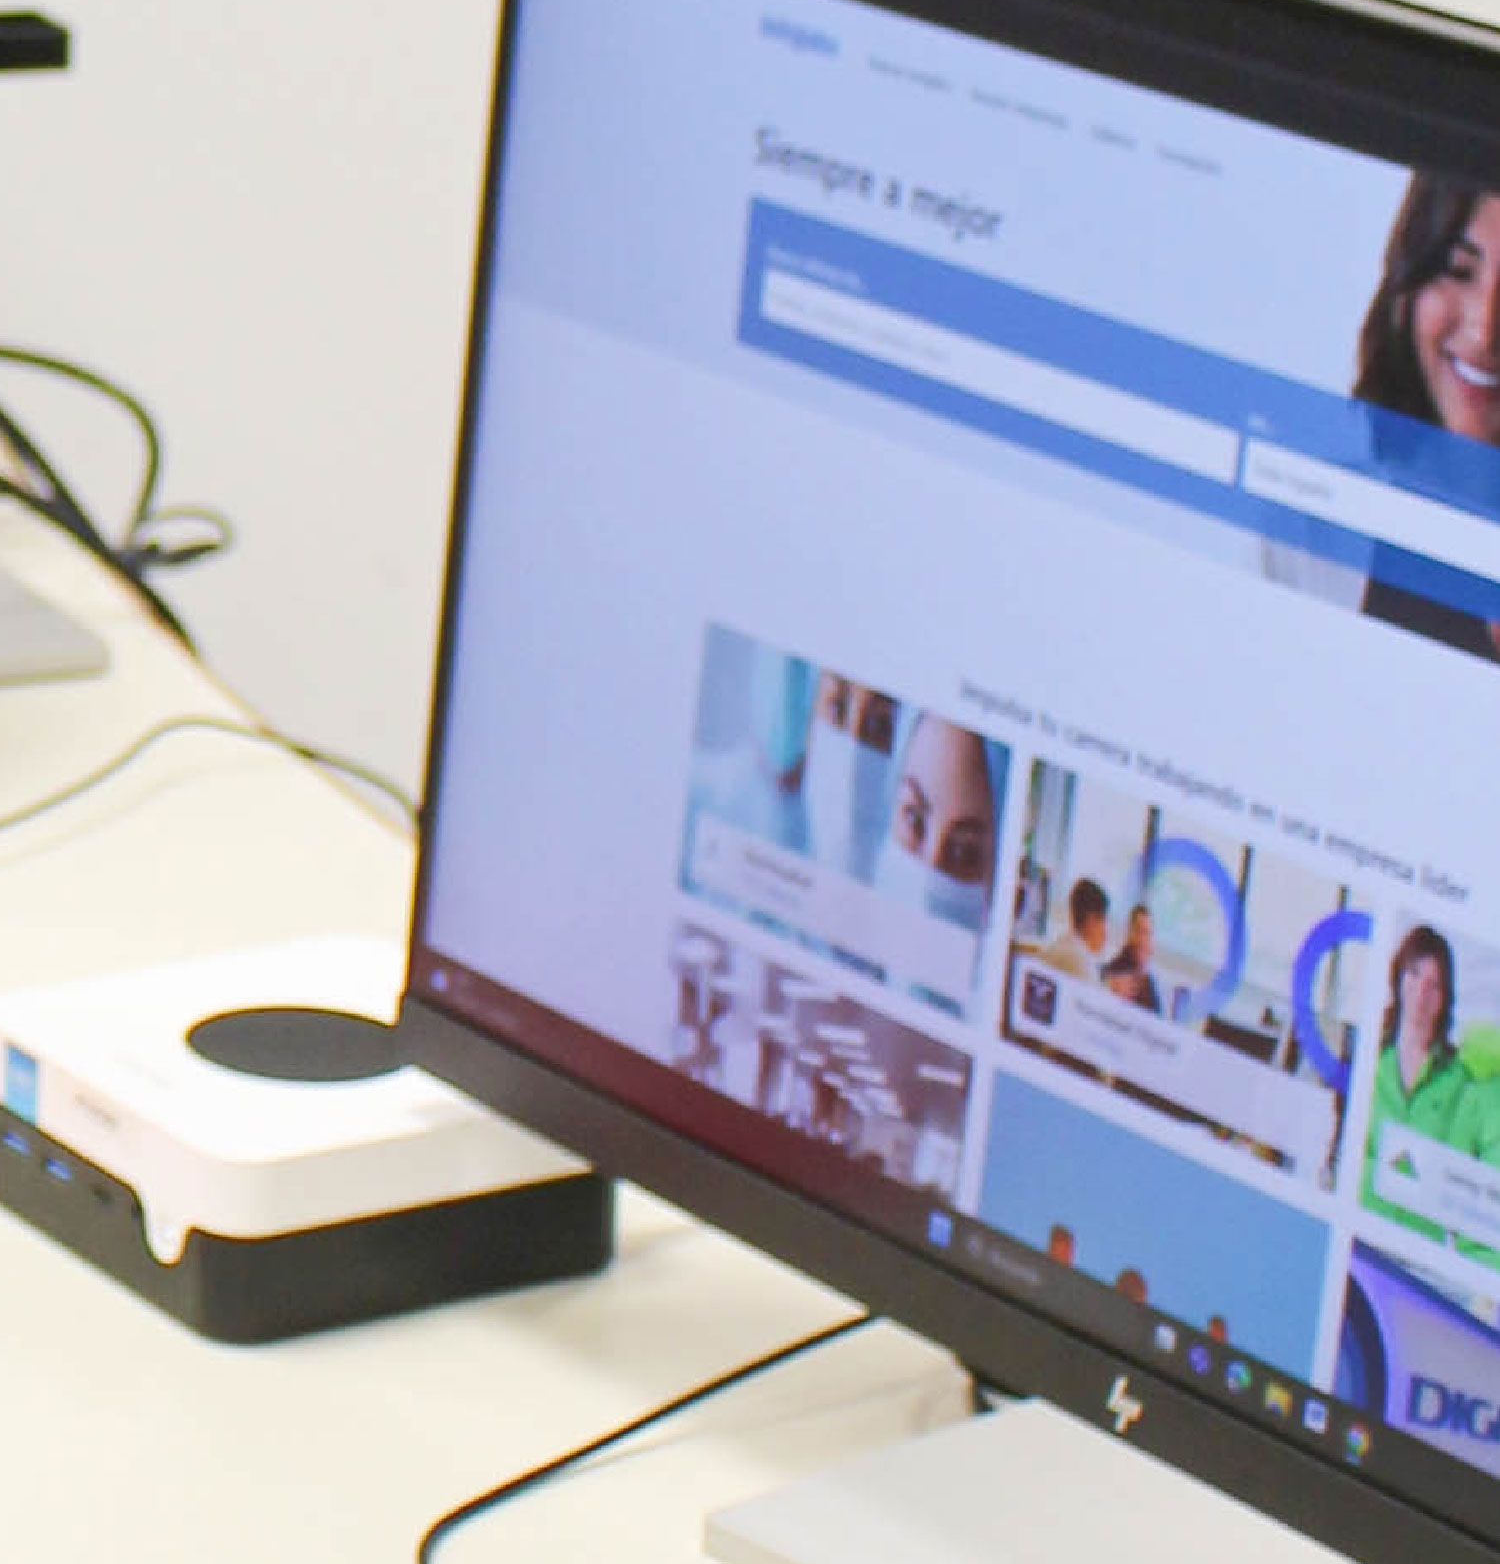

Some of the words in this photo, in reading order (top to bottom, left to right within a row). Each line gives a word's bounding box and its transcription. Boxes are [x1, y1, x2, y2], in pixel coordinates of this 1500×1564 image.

[753, 125, 873, 199] Siempre
[911, 185, 1003, 242] mejor
[1324, 833, 1415, 883] empresa
